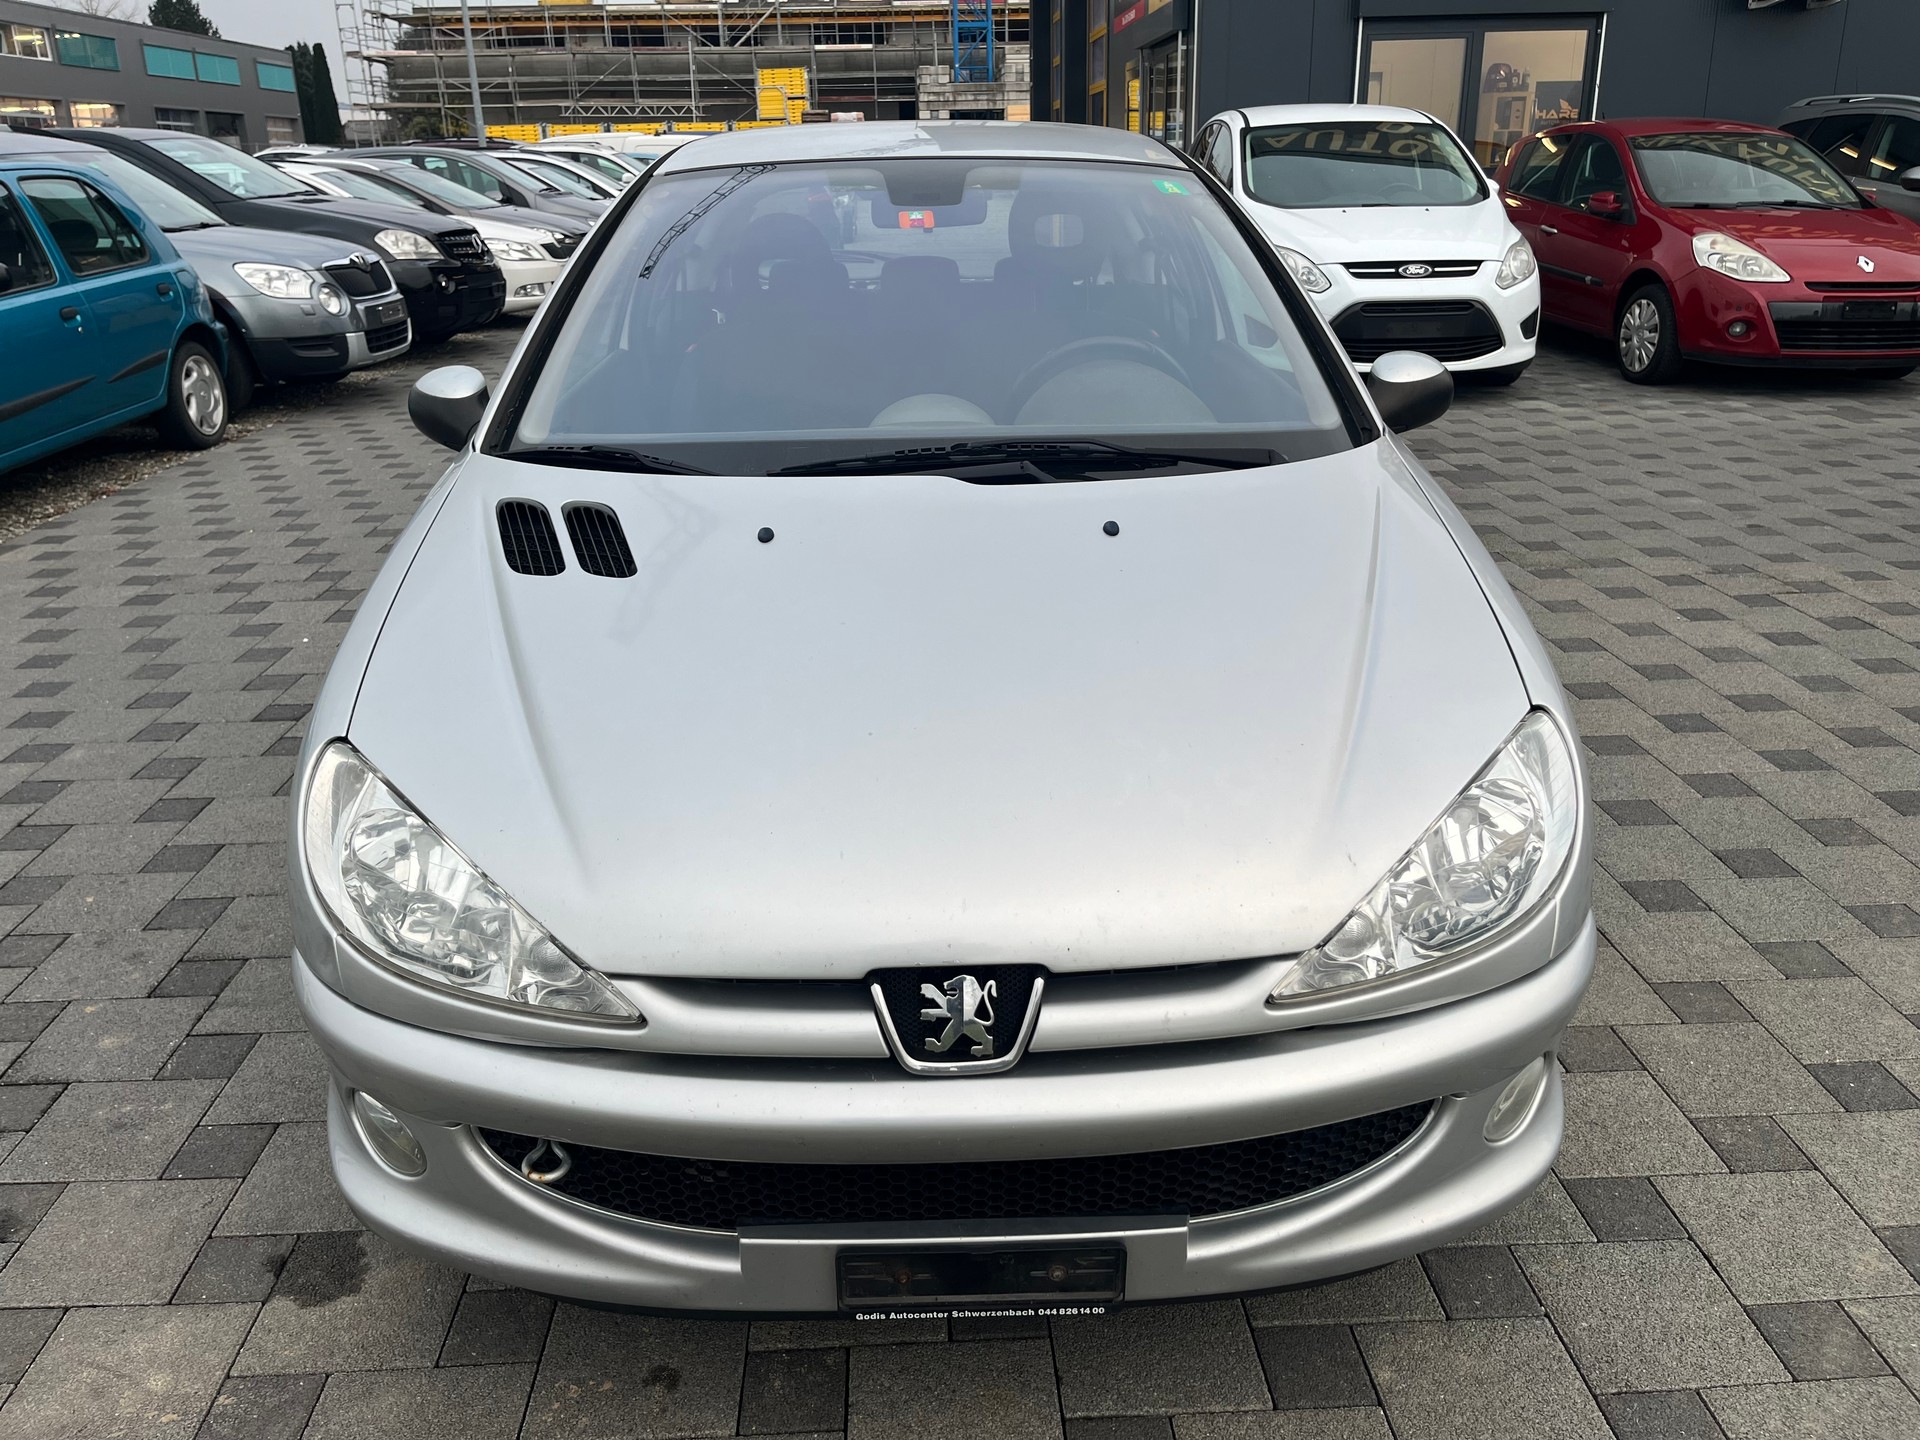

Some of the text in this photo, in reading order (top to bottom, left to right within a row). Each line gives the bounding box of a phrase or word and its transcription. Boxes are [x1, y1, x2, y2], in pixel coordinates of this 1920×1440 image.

[1406, 265, 1425, 274] Ford
[855, 1313, 886, 1321] Godis
[889, 1311, 949, 1320] Autocenter
[951, 1309, 1035, 1319] Schwerzenbach
[1038, 1308, 1058, 1316] 044
[1059, 1307, 1079, 1315] 826
